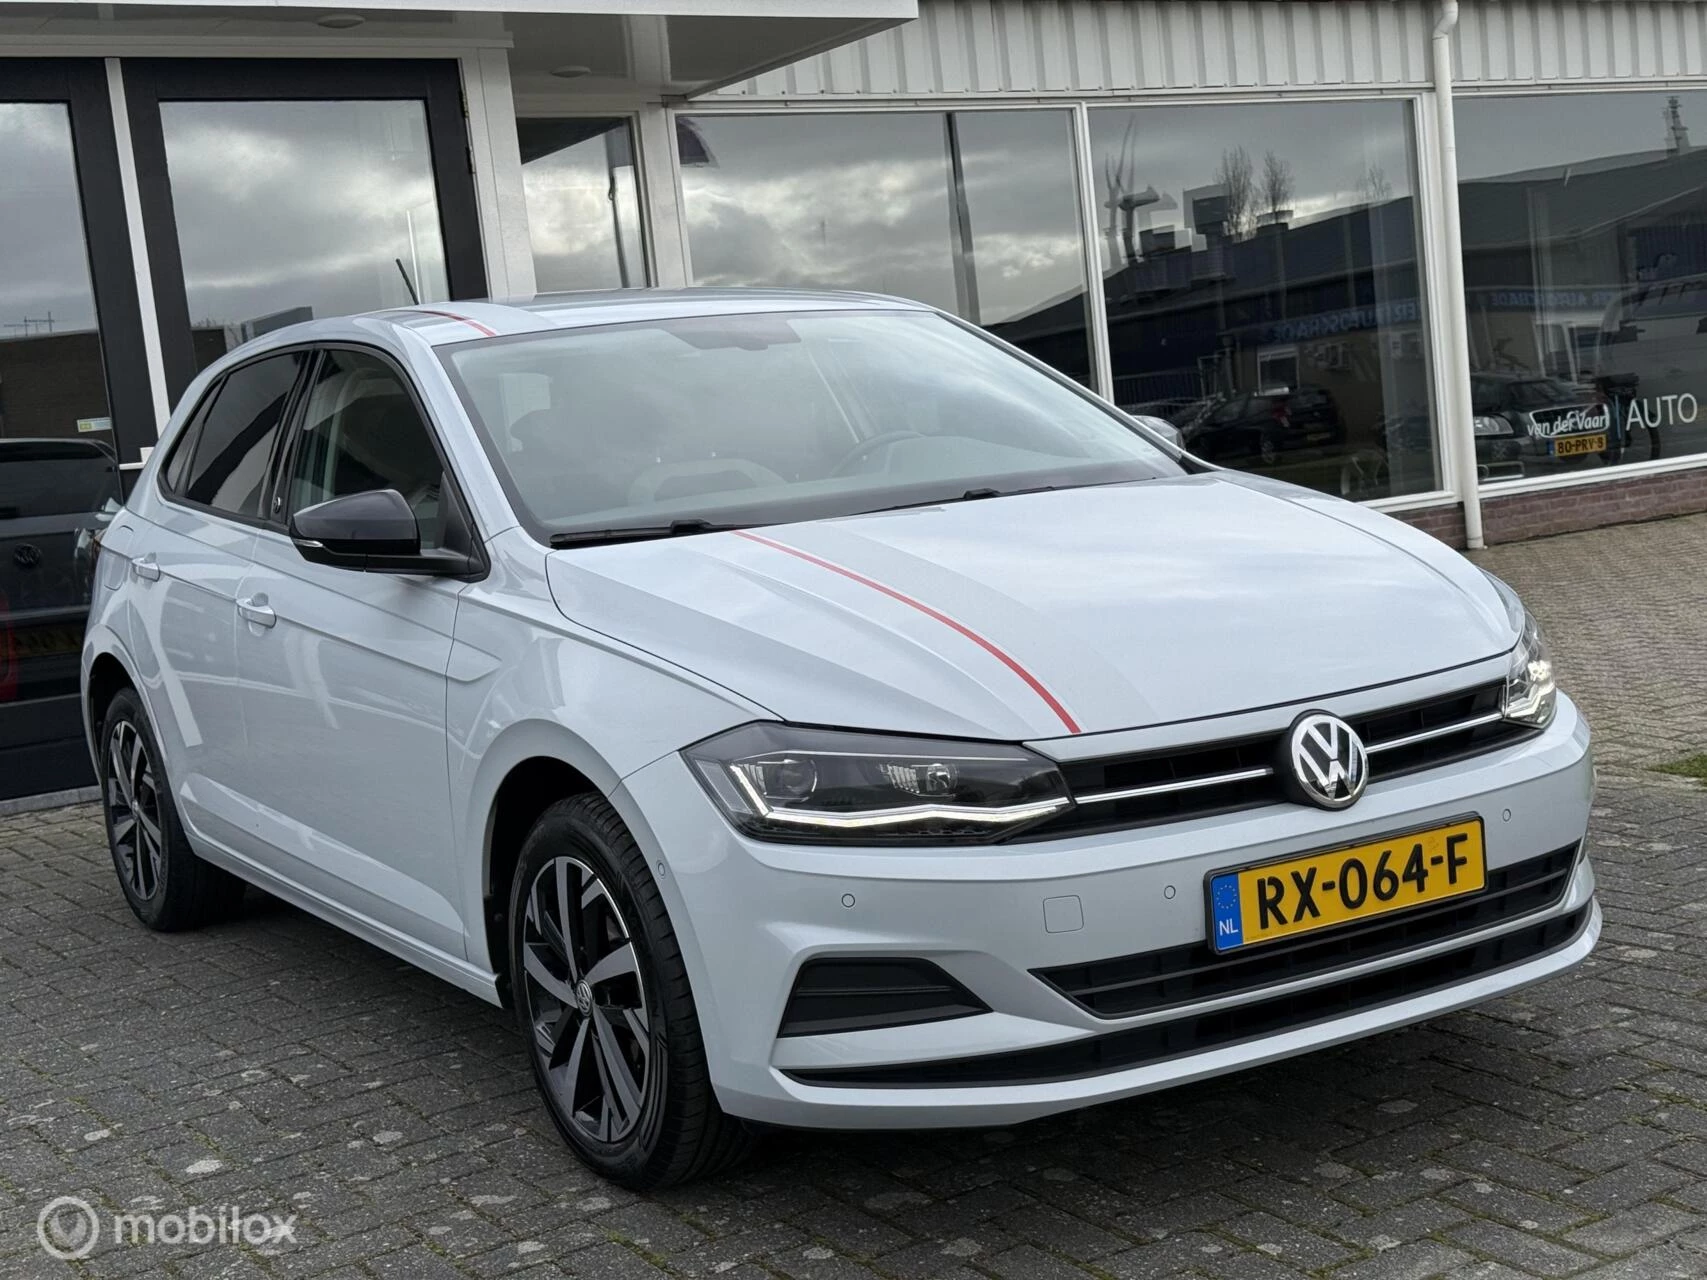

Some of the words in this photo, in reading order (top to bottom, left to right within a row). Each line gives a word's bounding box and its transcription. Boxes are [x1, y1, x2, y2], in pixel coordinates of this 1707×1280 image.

[1526, 421, 1551, 437] van
[1625, 392, 1698, 432] AUTO
[1219, 918, 1239, 937] NL
[1257, 832, 1468, 930] RX-064-F
